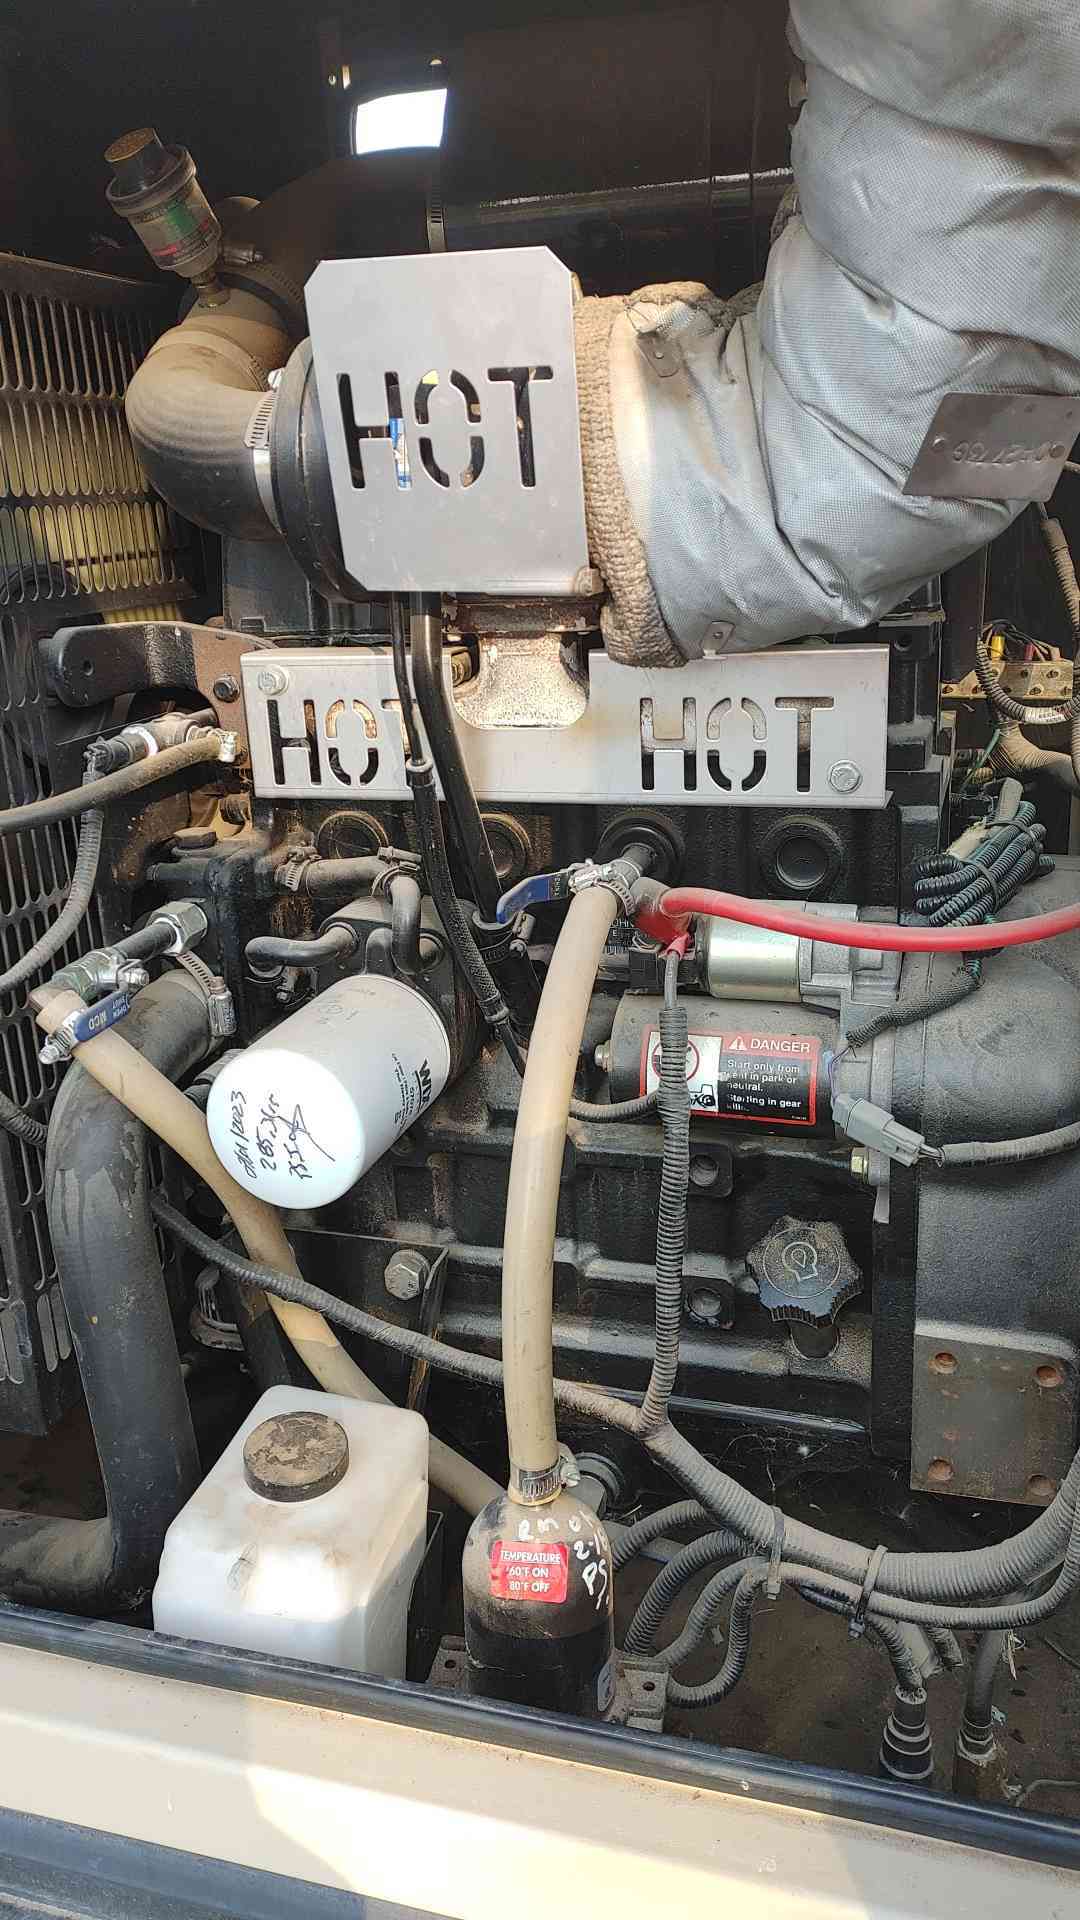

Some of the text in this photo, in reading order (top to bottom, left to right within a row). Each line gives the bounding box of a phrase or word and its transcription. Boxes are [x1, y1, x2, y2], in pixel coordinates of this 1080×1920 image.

[336, 365, 554, 489] HOT
[640, 696, 835, 794] HOT
[750, 1037, 811, 1054] DANGER
[753, 1062, 776, 1073] only
[777, 1063, 800, 1074] from
[750, 1071, 760, 1081] in
[767, 1097, 777, 1106] in
[779, 1099, 802, 1108] gear
[500, 1550, 561, 1563] TEMPERATURE
[531, 1567, 550, 1579] ON
[531, 1581, 551, 1593] OFF
